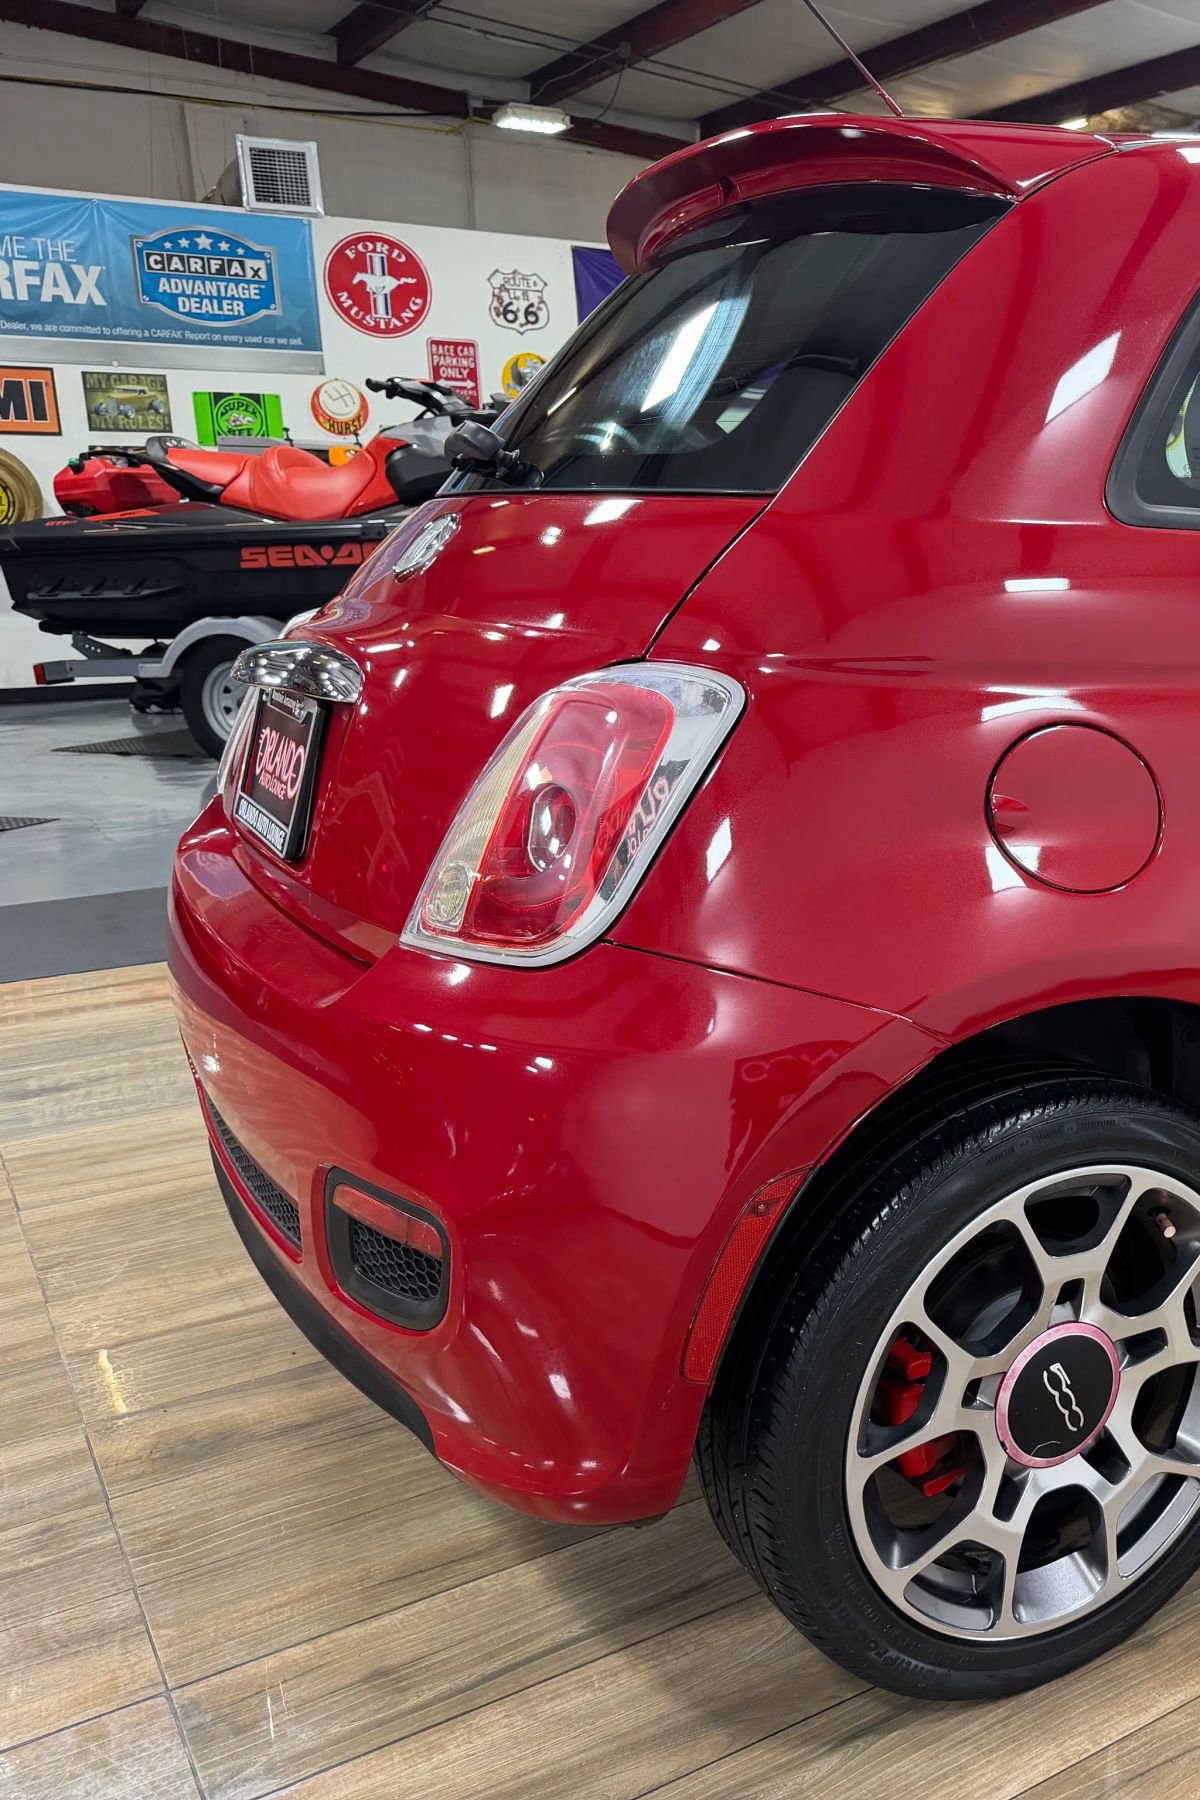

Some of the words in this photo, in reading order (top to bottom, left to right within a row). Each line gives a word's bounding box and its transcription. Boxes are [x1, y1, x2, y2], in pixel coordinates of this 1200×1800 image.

[32, 237, 77, 262] THE
[345, 241, 406, 262] FORD
[147, 252, 265, 280] CARFAX
[158, 277, 262, 300] ADVANTAGE
[503, 276, 532, 289] ROUTE
[178, 296, 246, 317] DEALER
[337, 291, 423, 329] MUSTANG
[503, 301, 539, 325] 66
[0, 320, 29, 331] Dealer,
[44, 324, 57, 332] are
[59, 324, 100, 335] committed
[102, 327, 111, 335] to
[112, 328, 142, 338] offering
[185, 331, 210, 342] Report
[223, 335, 243, 344] every
[244, 334, 262, 344] used
[431, 344, 455, 356] RACE
[457, 346, 474, 357] CAR
[432, 355, 475, 368] PARKING
[85, 373, 109, 388] MY
[111, 375, 165, 390] GARAGE
[440, 366, 469, 379] ONLY
[220, 401, 258, 418] SUPER
[90, 416, 116, 430] MY
[119, 416, 170, 431] RULES!
[328, 415, 363, 434] HURST
[256, 726, 305, 799] ORLANDO
[1043, 1362, 1085, 1432] 500
